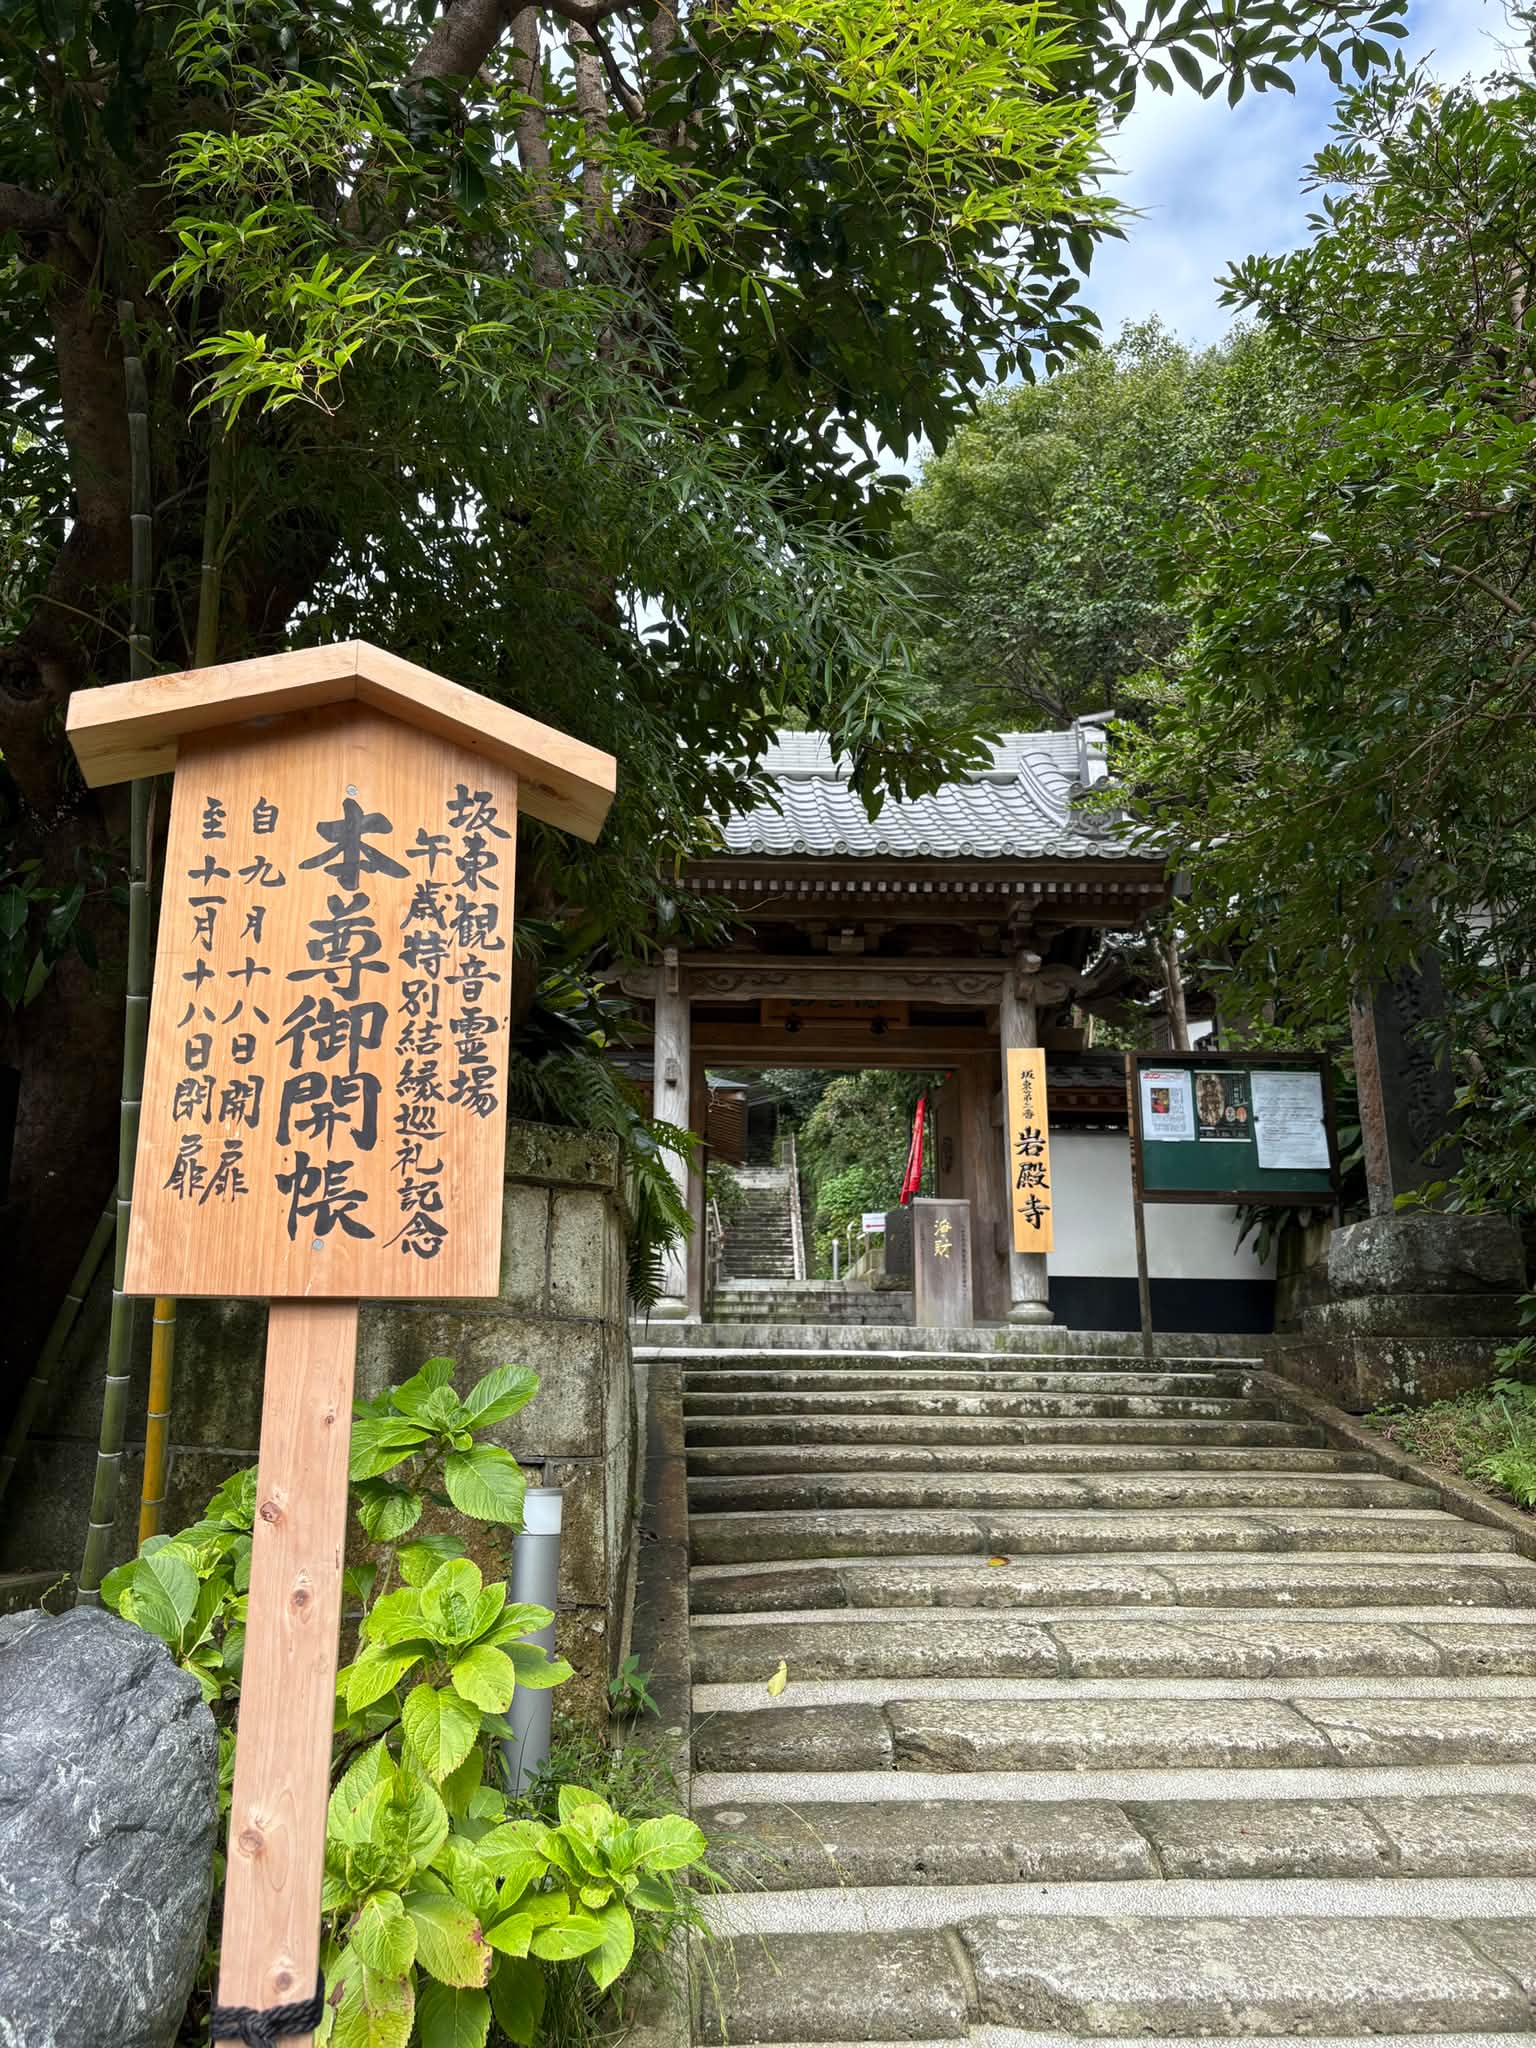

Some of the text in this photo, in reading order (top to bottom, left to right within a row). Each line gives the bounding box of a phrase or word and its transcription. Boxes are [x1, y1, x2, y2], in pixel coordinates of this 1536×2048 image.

[163, 796, 231, 1202] 至十一月十八日閉扉
[199, 796, 286, 1206] 自九月十八日開扉
[275, 798, 411, 1241] 本尊御開帳
[382, 827, 454, 1260] 午歳特別結縁巡礼記念
[445, 784, 512, 1119] 坂東観音霊場
[1014, 1125, 1051, 1230] 岩殿寺
